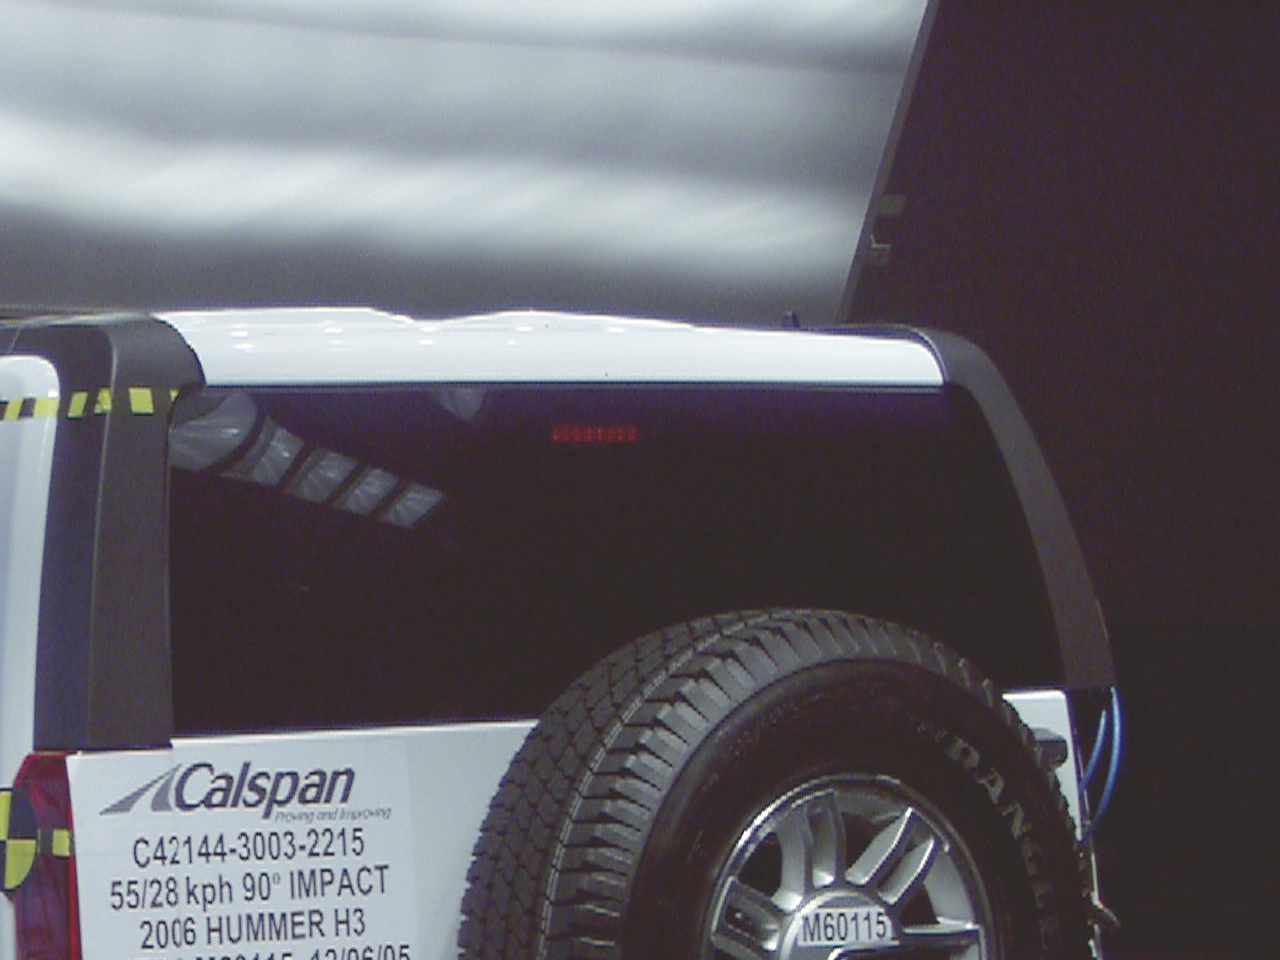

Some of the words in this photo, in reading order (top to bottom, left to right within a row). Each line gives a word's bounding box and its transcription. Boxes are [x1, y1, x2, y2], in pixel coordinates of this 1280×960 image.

[174, 761, 355, 820] Calspan
[274, 810, 315, 824] Proving
[316, 808, 338, 820] and
[339, 807, 392, 821] Improving
[132, 828, 365, 868] C42144-3003-2215
[110, 876, 179, 912] 55/28
[186, 874, 234, 912] kph
[289, 865, 390, 900] IMPACT
[140, 917, 197, 950] 2006
[206, 909, 326, 945] HUMMER
[334, 908, 367, 937] H3
[802, 912, 888, 942] M60115
